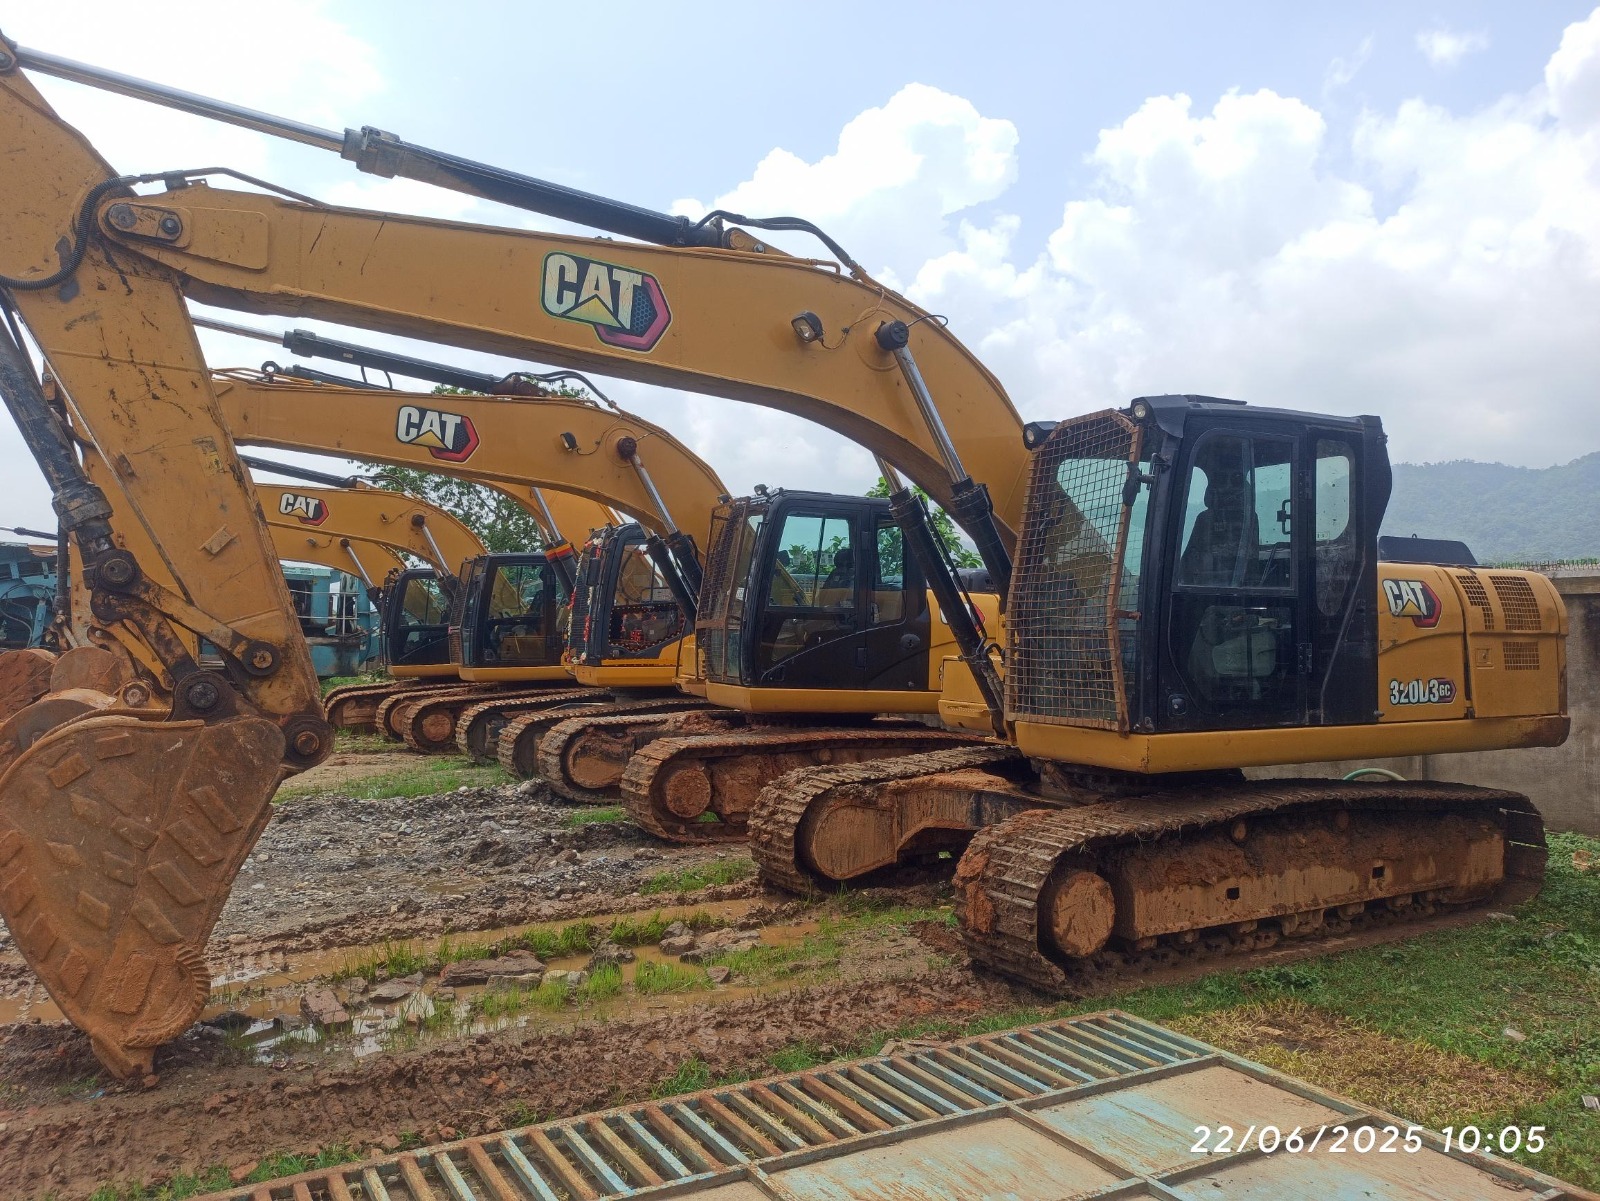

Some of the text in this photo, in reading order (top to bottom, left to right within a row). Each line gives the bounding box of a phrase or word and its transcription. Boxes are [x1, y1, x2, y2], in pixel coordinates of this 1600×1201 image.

[544, 253, 643, 330] CAT
[397, 405, 462, 450] CAT
[280, 493, 319, 519] CAT
[1383, 580, 1427, 616] CAT
[1439, 684, 1451, 696] GC
